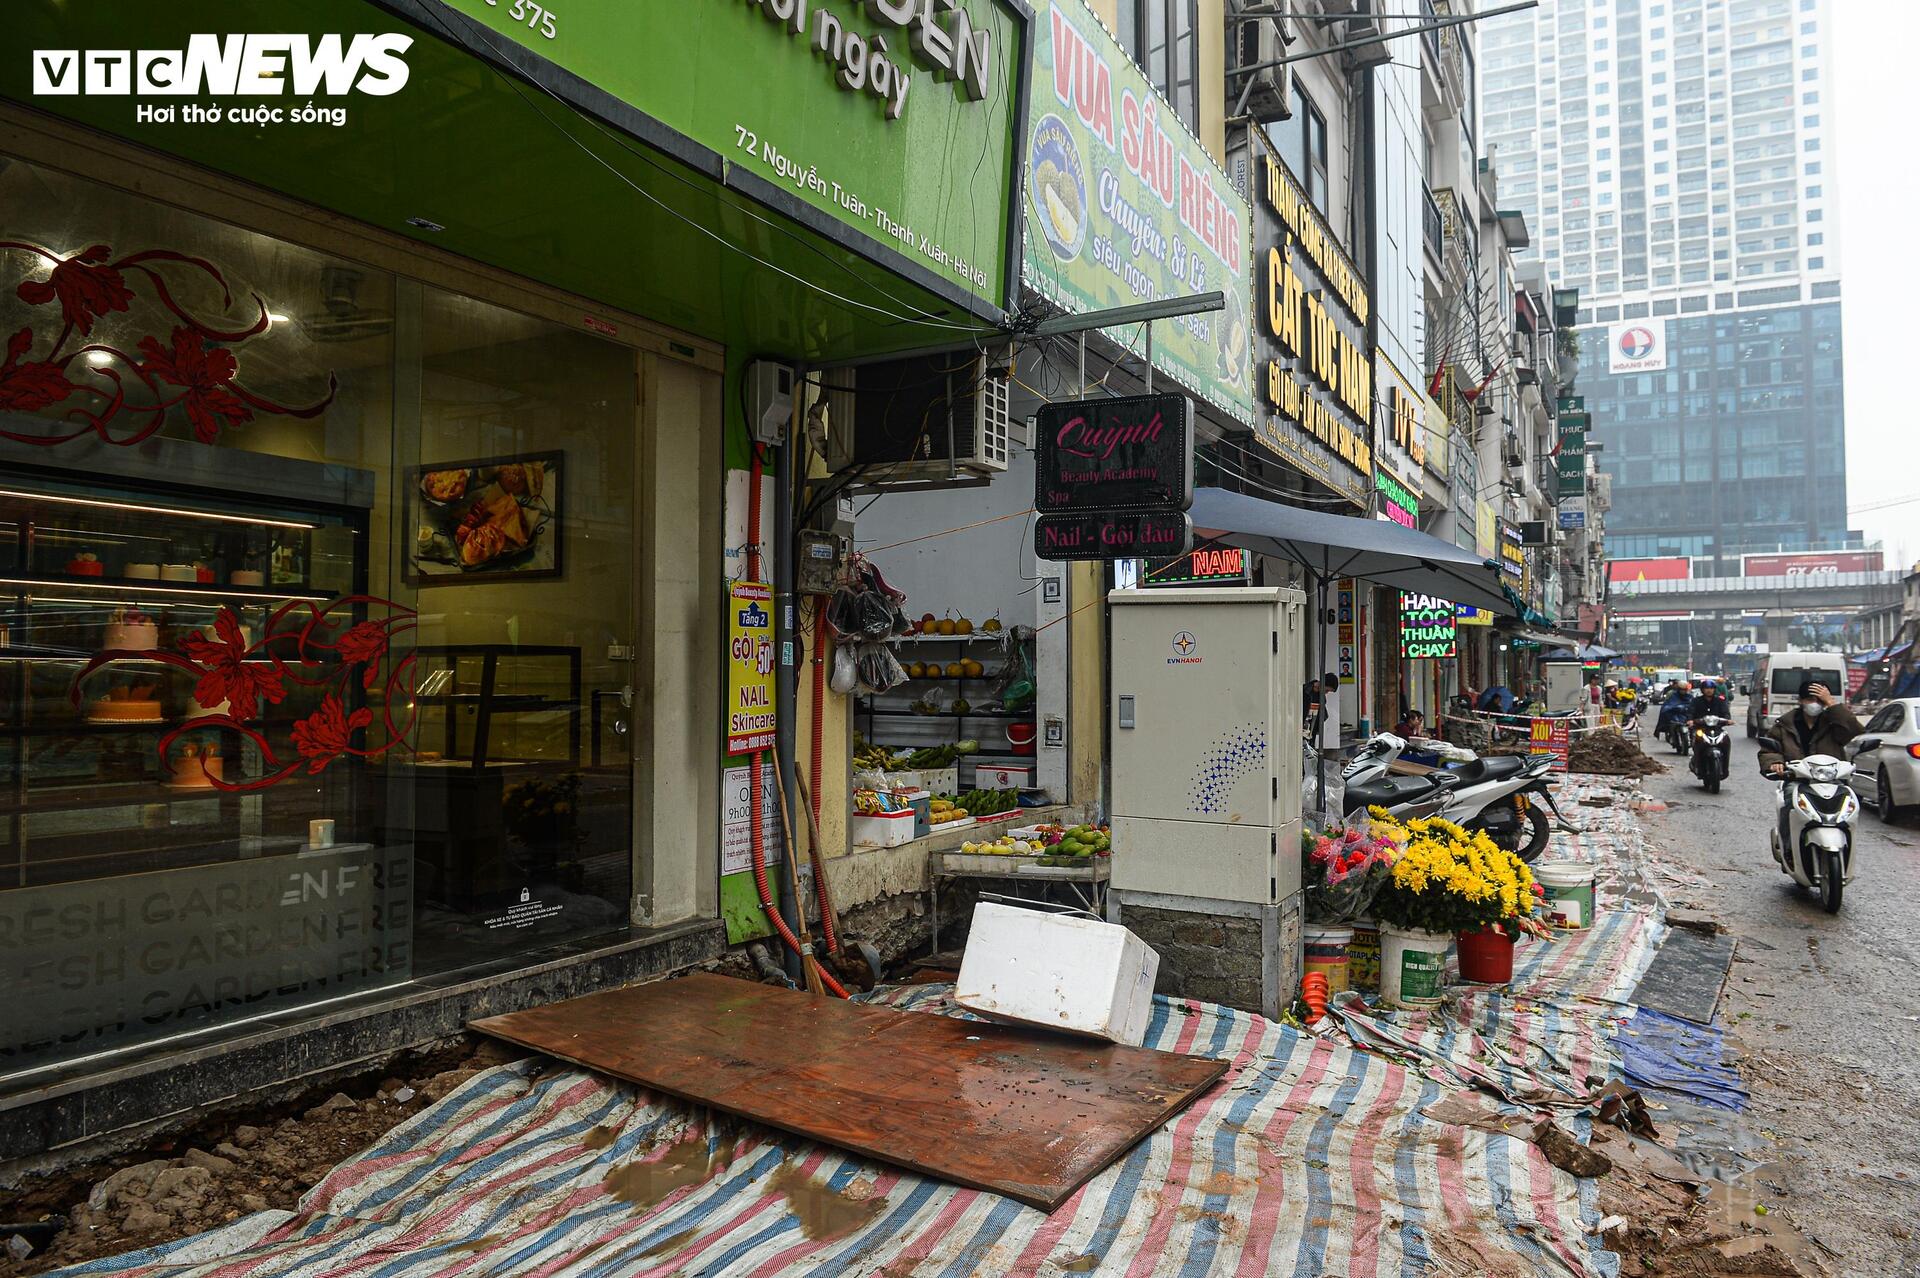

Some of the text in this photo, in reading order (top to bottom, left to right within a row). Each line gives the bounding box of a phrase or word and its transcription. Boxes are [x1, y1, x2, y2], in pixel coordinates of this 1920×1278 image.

[509, 0, 557, 39] 375
[817, 8, 910, 120] ngày
[1050, 7, 1240, 274] VUA SẦU RIÊNG
[735, 124, 757, 157] 72
[762, 141, 828, 197] Nguyễn
[968, 264, 988, 290] Nội
[1093, 236, 1121, 277] siêu
[1123, 258, 1156, 302] ngon
[1299, 202, 1324, 269] CÔNG
[1323, 237, 1351, 308] BARBER
[1351, 278, 1369, 327] SHOP
[1187, 314, 1210, 346] sạch
[1268, 231, 1371, 426] CẮT TÓC NAM
[1268, 358, 1284, 416] GỘI
[1284, 368, 1301, 422] ĐẦU
[1056, 411, 1164, 460] Quỳnh
[1061, 467, 1157, 484] Beauty Academy
[1048, 489, 1069, 505] Spa
[1044, 526, 1081, 547] Nail
[1192, 549, 1243, 576] NAM
[760, 615, 766, 625] 2
[1406, 607, 1449, 626] TÓC
[732, 630, 755, 667] GỘI
[1407, 643, 1450, 658] CHAY
[1736, 645, 1757, 653] ACB
[740, 686, 769, 707] NAIL
[732, 712, 775, 733] Skincare
